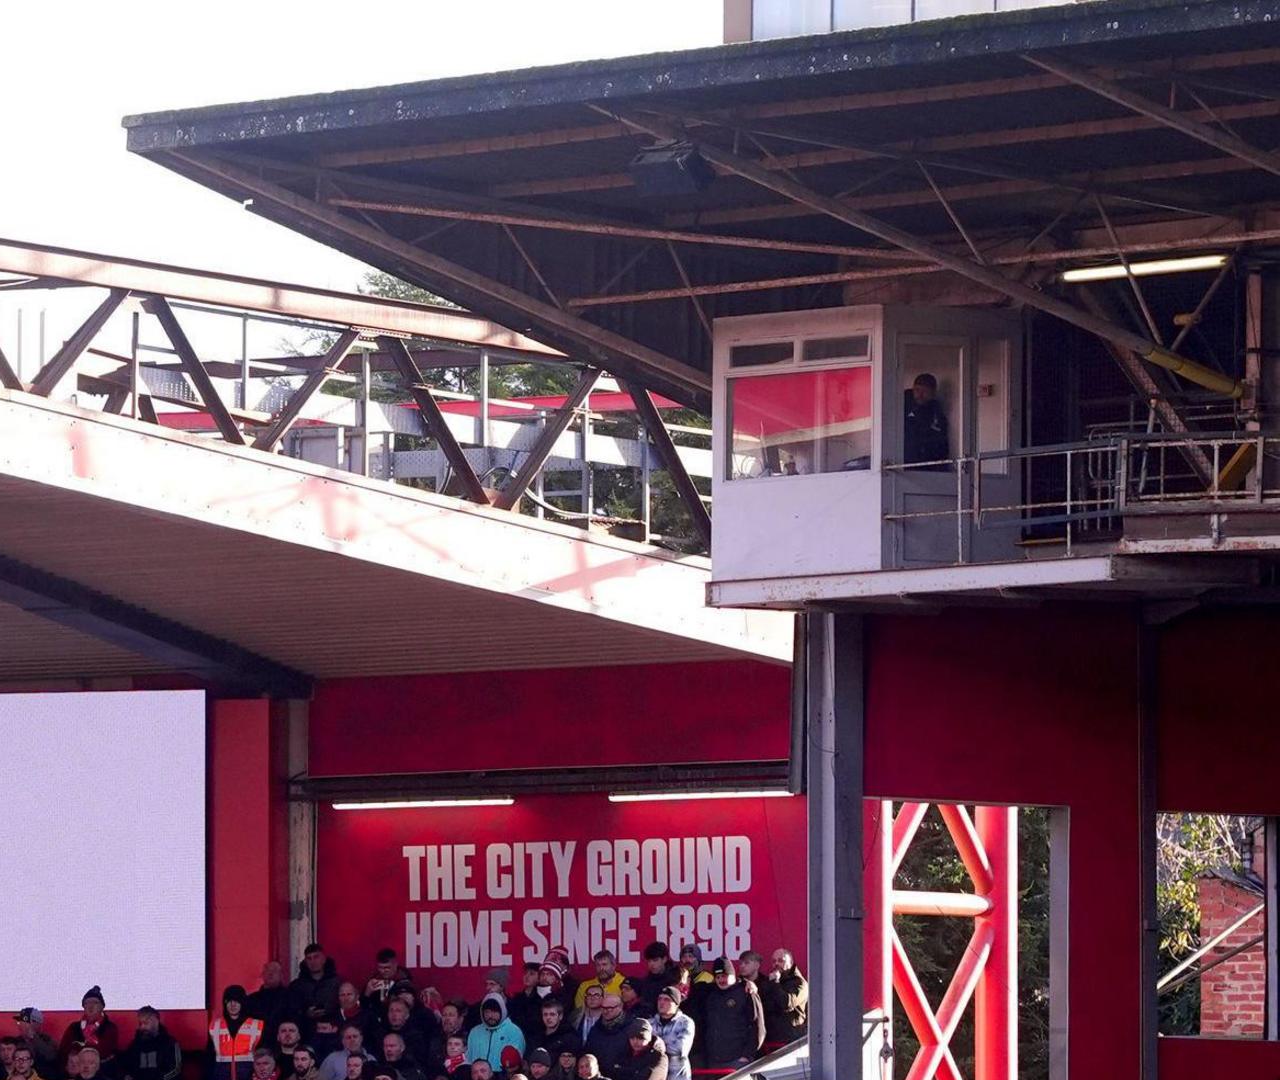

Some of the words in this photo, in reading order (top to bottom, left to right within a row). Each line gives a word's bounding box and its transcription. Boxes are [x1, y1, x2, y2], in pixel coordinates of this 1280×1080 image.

[402, 844, 476, 901] THE
[486, 841, 577, 899] CITY
[586, 836, 752, 896] GROUND
[405, 910, 512, 968] HOME
[523, 906, 640, 966] SINCE
[650, 903, 751, 962] 1898
